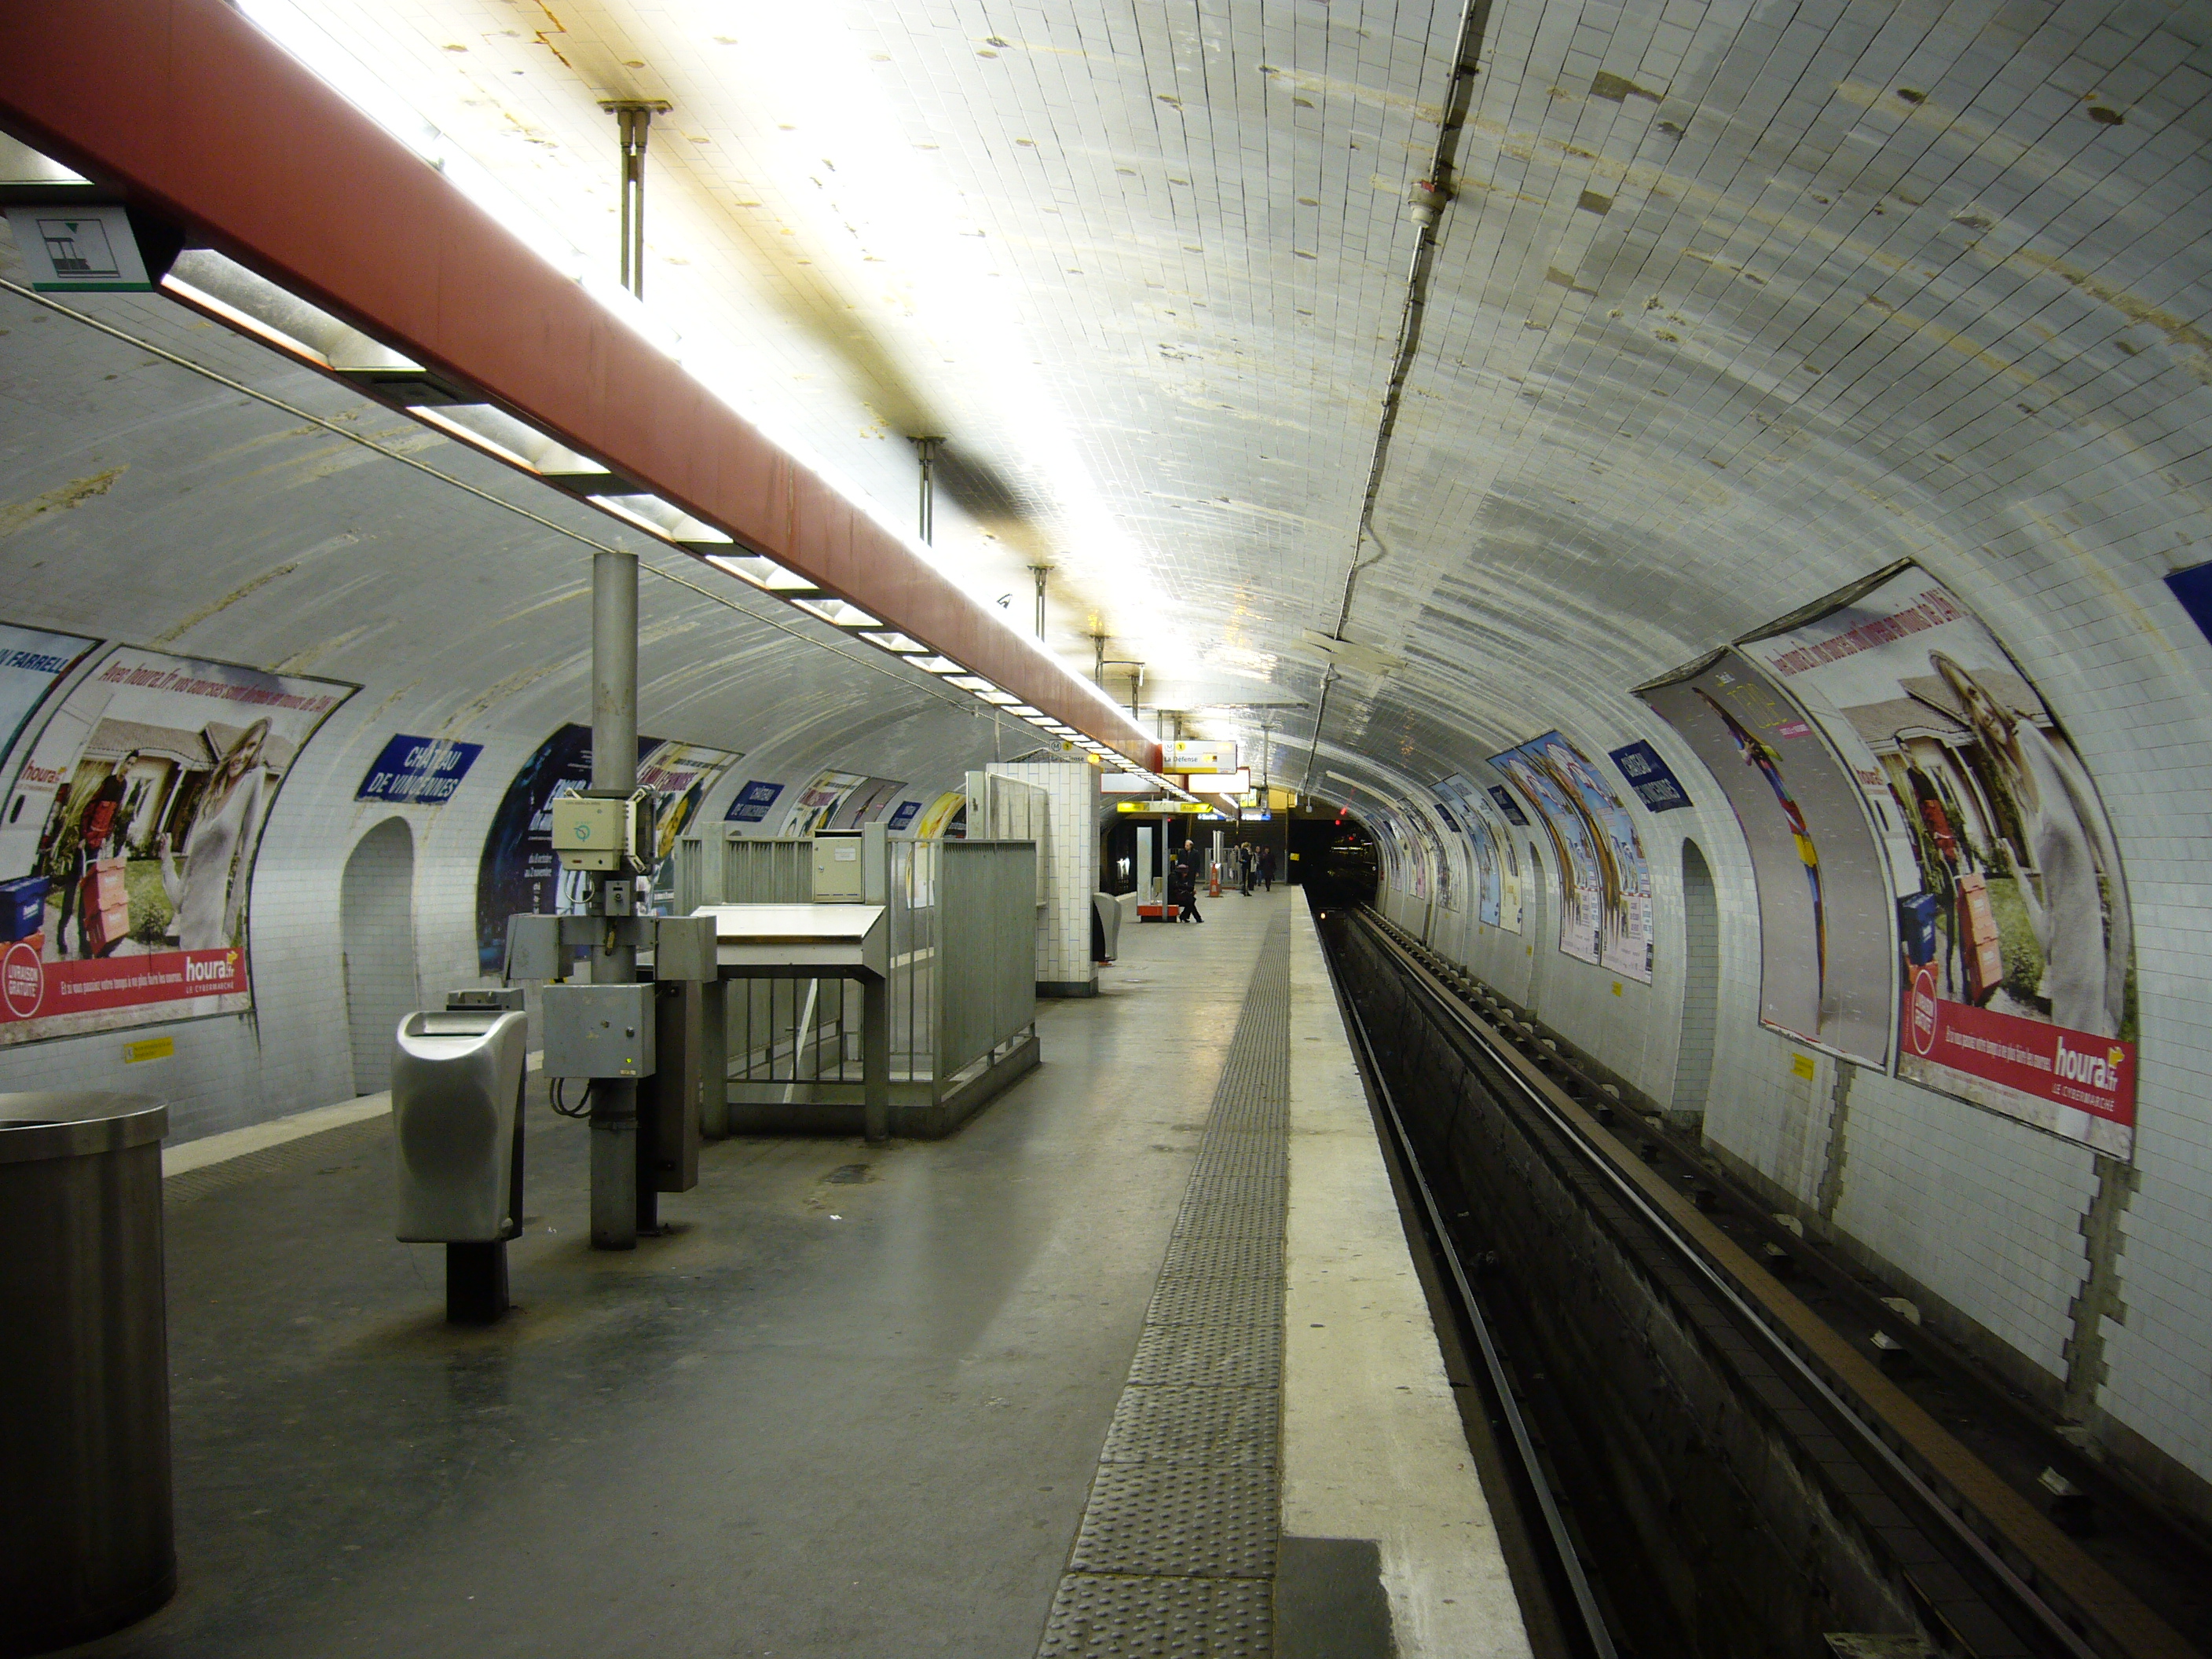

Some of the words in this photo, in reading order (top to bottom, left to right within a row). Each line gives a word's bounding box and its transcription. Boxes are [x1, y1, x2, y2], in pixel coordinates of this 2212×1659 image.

[4, 651, 69, 675] FARRELL
[367, 772, 393, 793] DE
[388, 774, 459, 797] VINCENNES
[8, 964, 38, 983] LIVRAISON
[185, 955, 236, 983] houra.fr
[9, 980, 38, 998] GRATUITE
[2053, 1036, 2119, 1092] houra.fr
